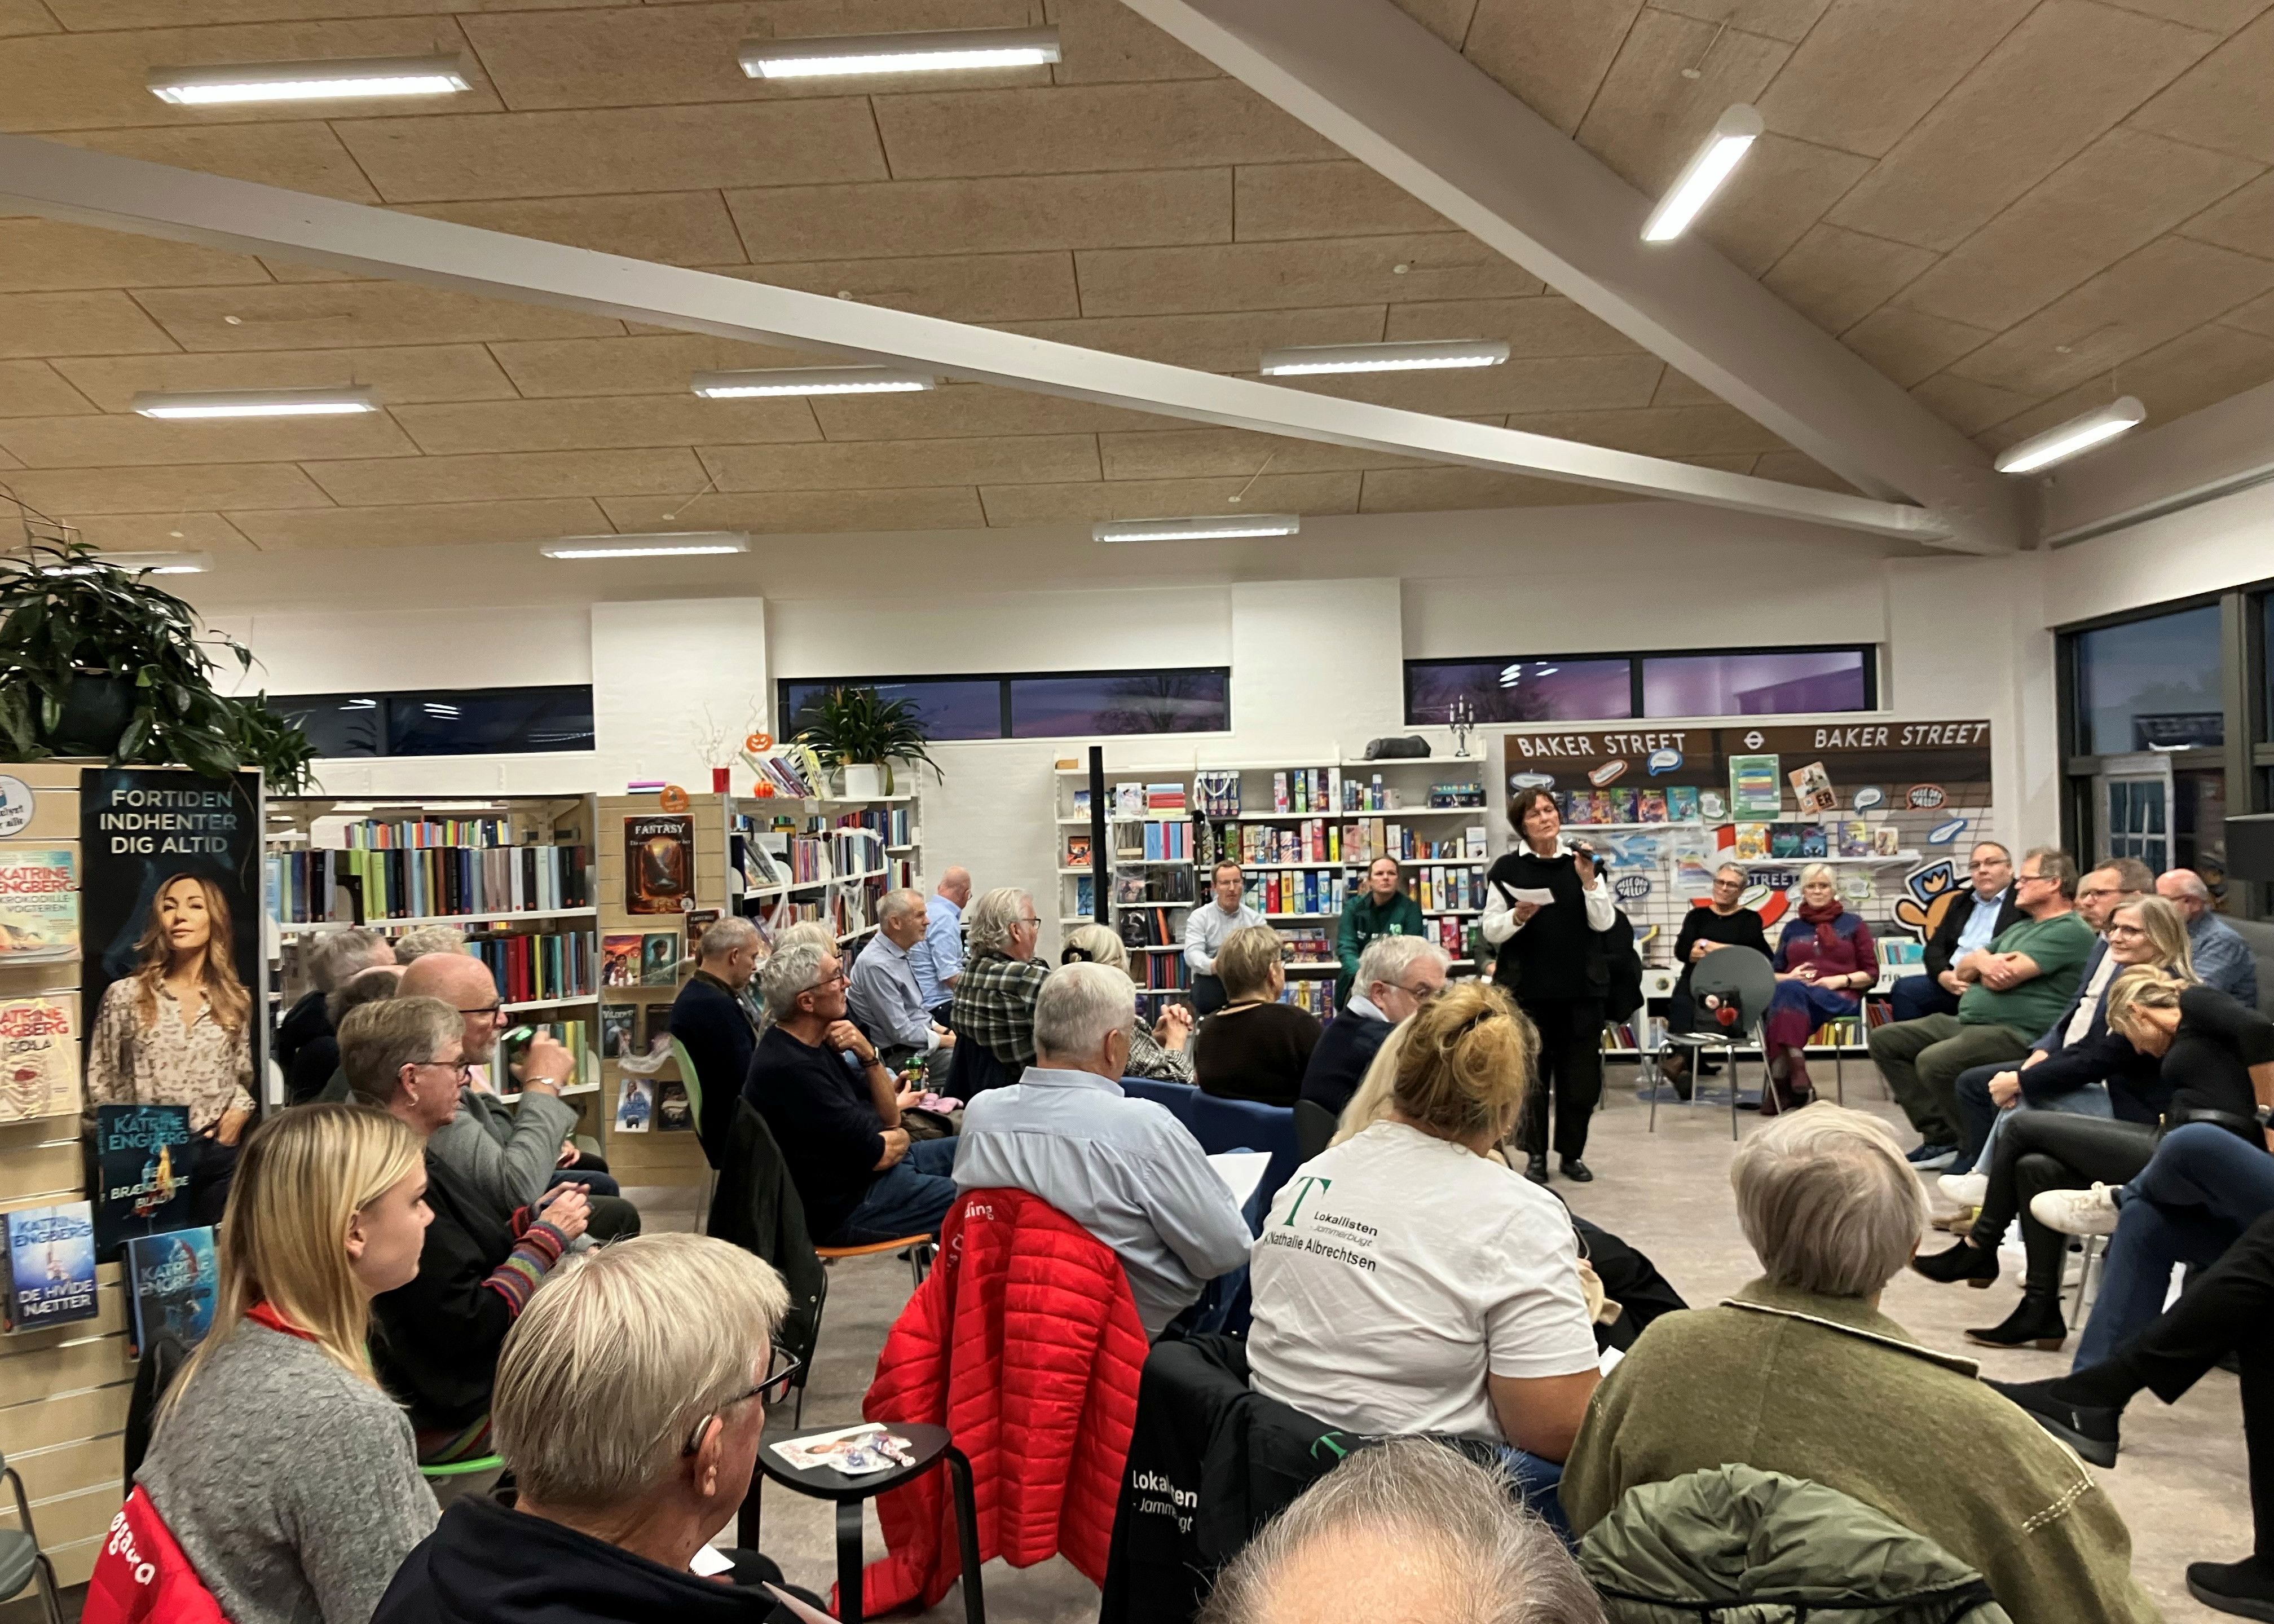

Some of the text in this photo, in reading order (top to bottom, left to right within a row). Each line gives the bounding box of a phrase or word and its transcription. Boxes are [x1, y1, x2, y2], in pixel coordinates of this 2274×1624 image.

[1517, 732, 1686, 757] BAKER STREET
[1814, 722, 1989, 748] BAKER STREET
[111, 789, 232, 807] FORTIDEN
[99, 813, 237, 830] INDHENTER
[635, 823, 686, 835] FANTASY
[111, 836, 228, 854] DIG ALTID
[0, 1006, 64, 1023] ATRINE
[0, 1020, 69, 1038] NGBERG
[114, 1113, 184, 1133] KATRINE
[108, 1130, 190, 1151] ENGBERG
[1314, 1211, 1378, 1237] Lokallisten
[1271, 1231, 1303, 1250] Nathalie
[1304, 1238, 1377, 1272] Albrechtsen
[19, 1279, 94, 1304] DE HVIDE
[23, 1294, 92, 1317] NÆTTER
